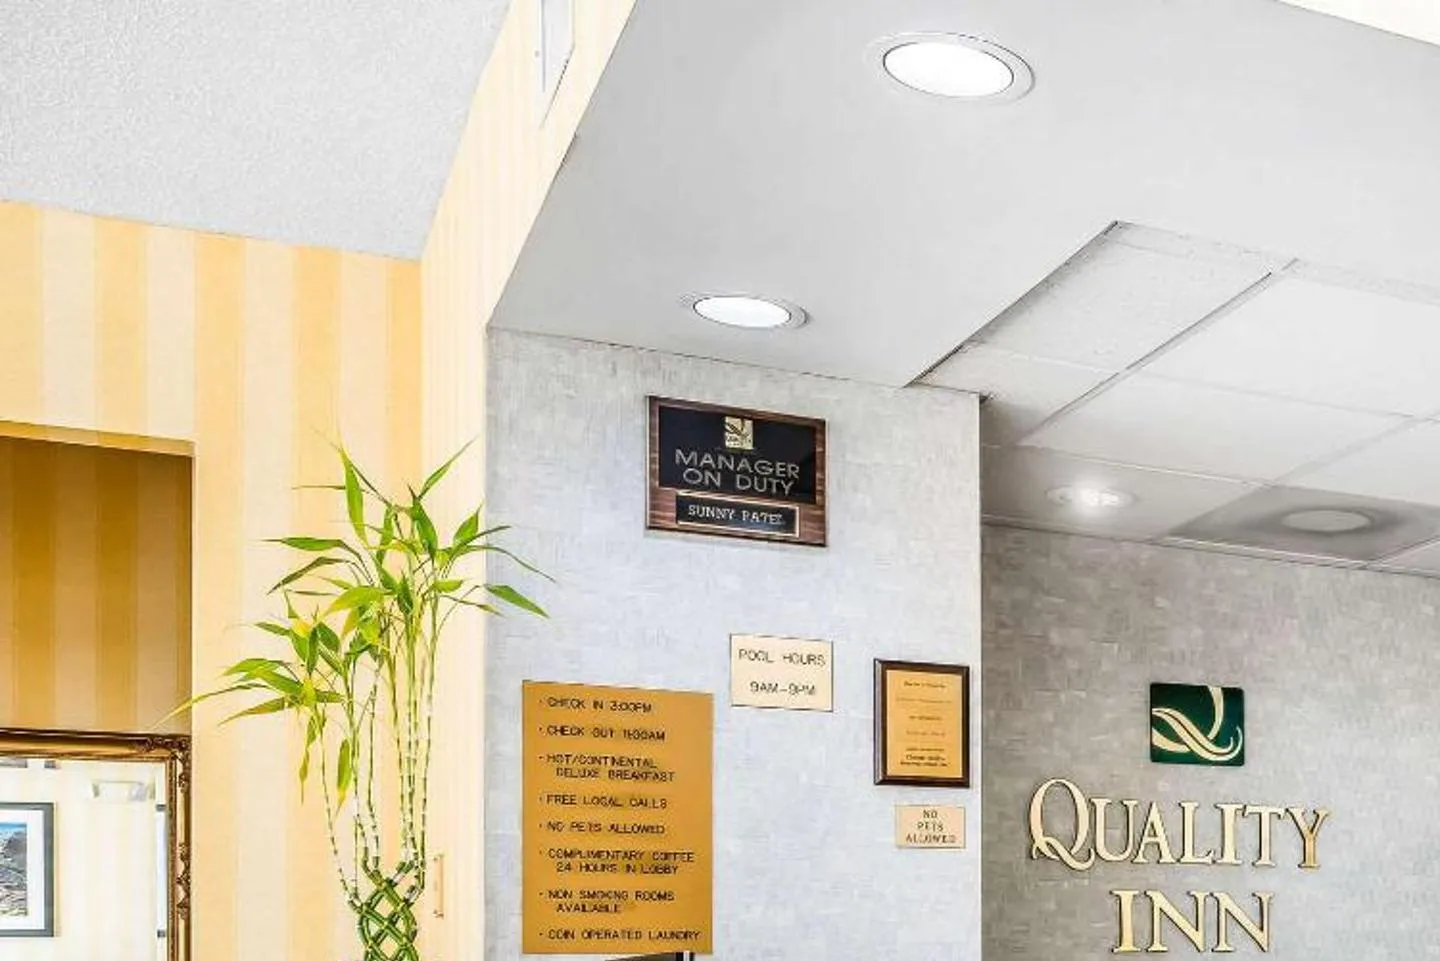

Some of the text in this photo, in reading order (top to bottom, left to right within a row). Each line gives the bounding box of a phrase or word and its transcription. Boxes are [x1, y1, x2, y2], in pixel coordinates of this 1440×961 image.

[675, 449, 800, 479] MANAGER
[683, 468, 795, 495] ON DUTY
[688, 504, 735, 521] SUNNY
[738, 648, 826, 667] POOL HOURS
[547, 697, 653, 713] CHECK IN 3:00PM
[547, 725, 585, 737] CHECK
[592, 727, 614, 739] OUT
[547, 754, 658, 769] HOT/CONTINENTAL
[556, 768, 675, 782] DELUXE BREAKFAST
[547, 794, 668, 809] FREE LOCAL CALLS
[923, 809, 938, 819] NO
[547, 821, 666, 834] NO PETS ALLOWED
[918, 821, 944, 832] PETS
[1028, 777, 1331, 872] QUALITY
[906, 833, 957, 844] ALLOWED
[652, 852, 695, 863] COFFEE
[556, 862, 679, 875] 24 HOURS IN LOBBY
[548, 889, 675, 902] NON SMOKING ROOMS
[556, 903, 623, 914] AVAILABLE
[1109, 888, 1274, 954] INN
[548, 928, 701, 941] COIN OPERATED LAUNDRY
